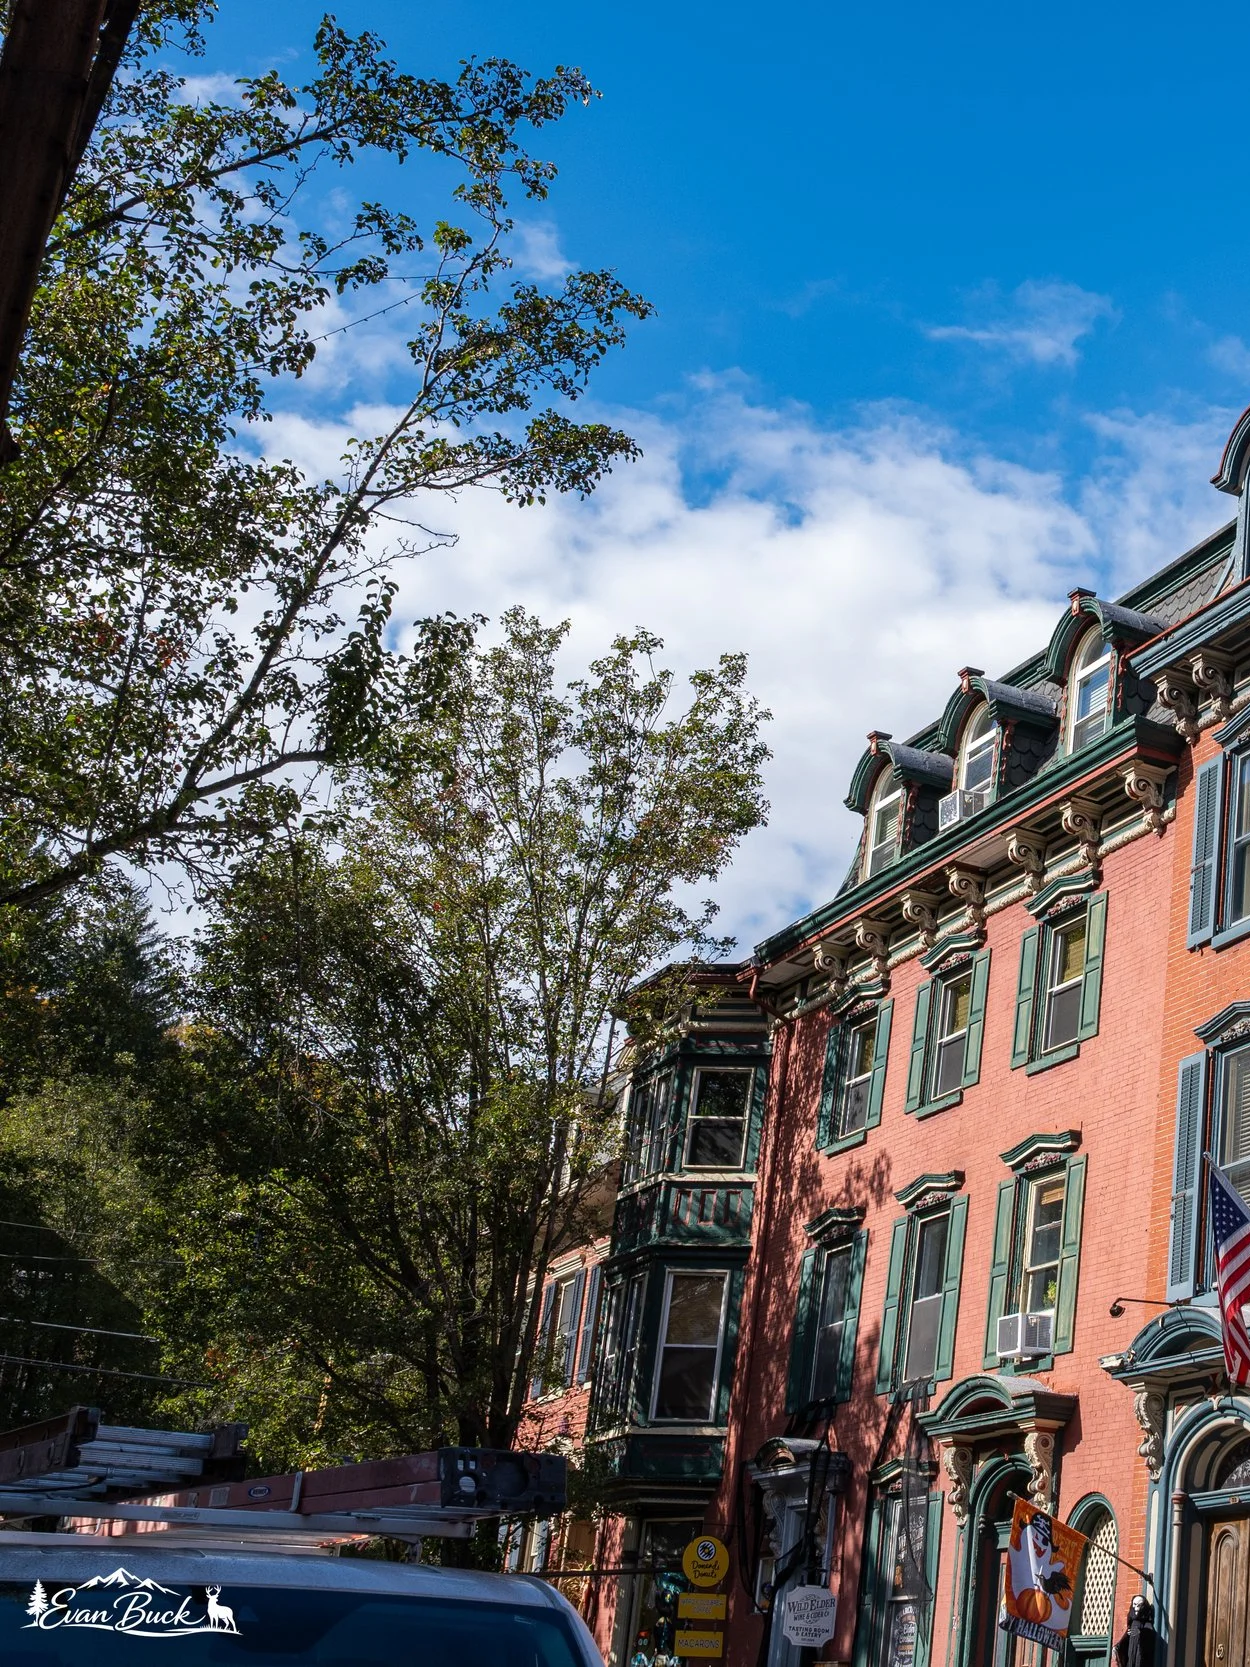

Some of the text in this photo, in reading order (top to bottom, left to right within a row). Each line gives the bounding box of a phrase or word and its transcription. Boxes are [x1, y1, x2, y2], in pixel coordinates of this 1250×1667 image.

[787, 1598, 836, 1613] WILD ELDER
[788, 1625, 830, 1635] TASTING ROOM
[1016, 1618, 1065, 1654] HALLOWEEN
[677, 1638, 720, 1649] MACARONS
